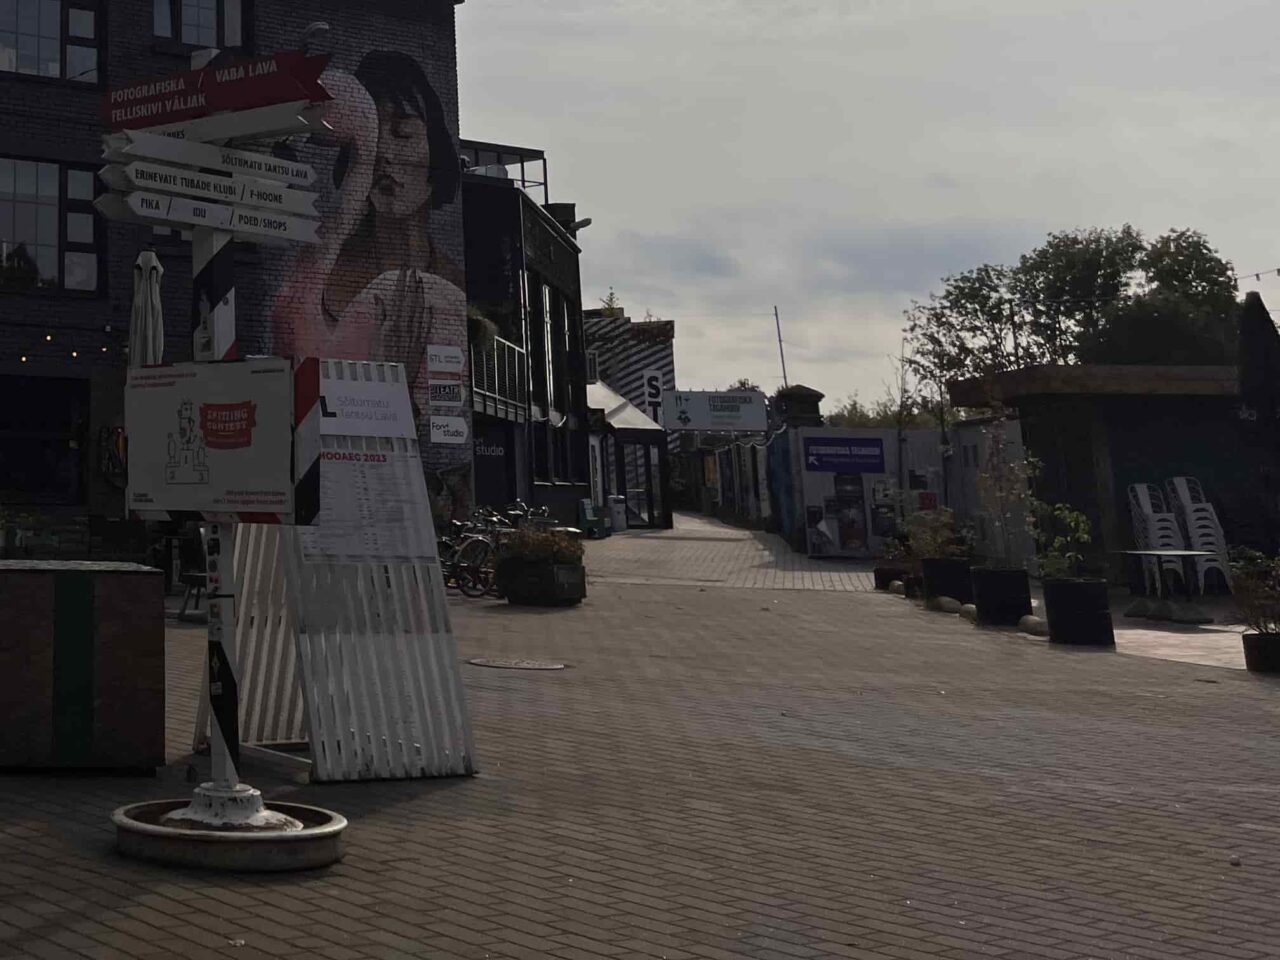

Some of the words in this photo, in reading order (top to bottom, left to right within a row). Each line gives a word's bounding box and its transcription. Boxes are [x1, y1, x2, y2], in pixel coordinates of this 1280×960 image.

[111, 78, 185, 104] FOTOGRAFISKA
[215, 64, 244, 83] VABA
[249, 59, 278, 78] LAVA
[111, 100, 163, 123] TELLISKIVI
[165, 93, 207, 113] VÄLJAK
[222, 154, 262, 171] SÕLTUMATU
[264, 162, 290, 176] TANTSU
[291, 168, 308, 180] LAVA
[135, 168, 177, 186] ERINEVATE
[180, 177, 211, 192] TUBADE
[213, 182, 236, 196] KLUBI
[250, 188, 283, 204] F-HOONE
[140, 198, 160, 211] FIKA
[193, 207, 207, 219] IDU
[238, 214, 287, 232] POED/SHOPS
[475, 443, 504, 456] studio
